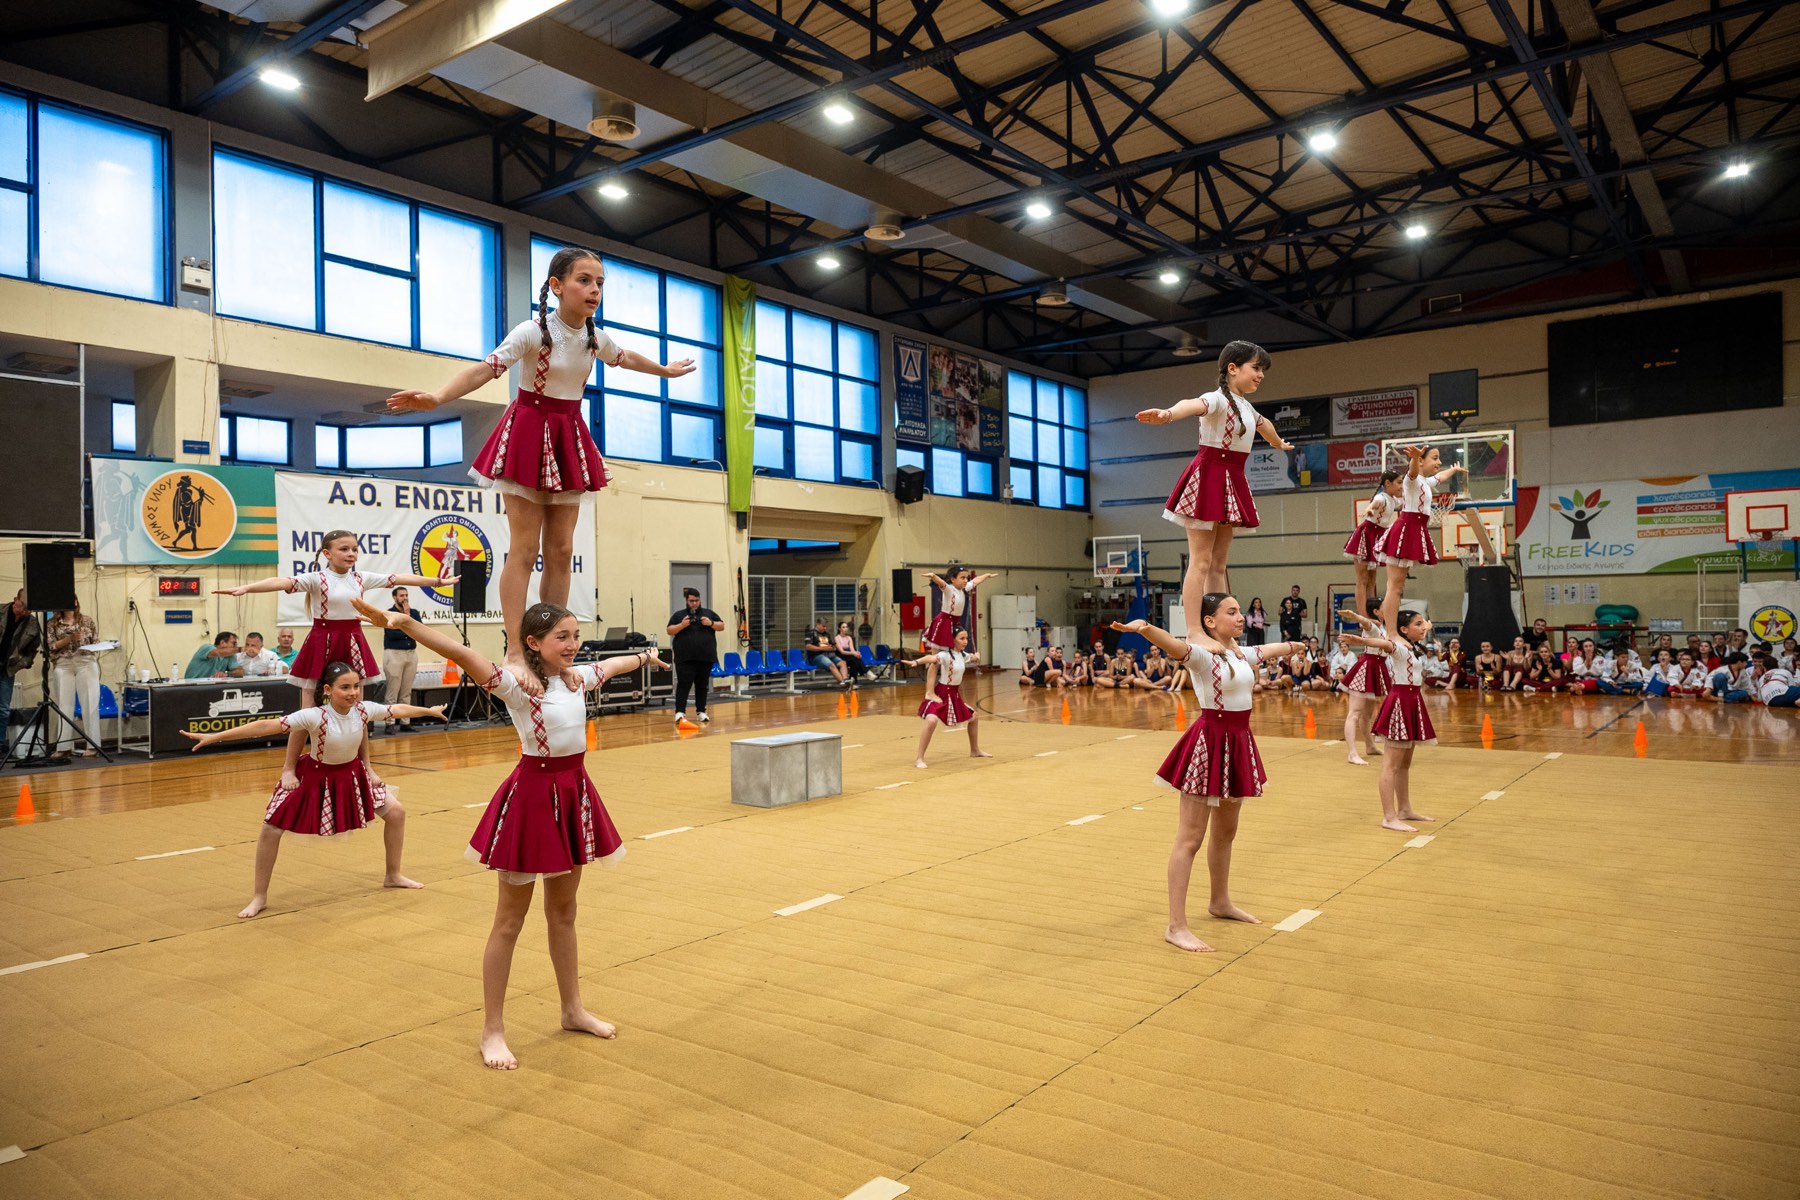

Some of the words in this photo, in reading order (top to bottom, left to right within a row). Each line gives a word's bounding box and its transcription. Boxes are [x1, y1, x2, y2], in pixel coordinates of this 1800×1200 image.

[1381, 391, 1414, 399] ΤΕΛΕΤΩΝ
[1351, 398, 1413, 411] ΦΩΤΕΙΝΟΠΟΥΛΟΥ
[1362, 408, 1402, 418] ΜΗΤΡΕΛΟΣ
[149, 478, 172, 503] ΙΛΙΟΥ
[328, 481, 382, 507] Α.Ο.
[395, 485, 483, 513] ΕΝΩΣΗ
[1653, 490, 1717, 503] λογοθεραπεία
[1653, 503, 1717, 513] εργοθεραπεία
[147, 505, 171, 541] ΔΗΜΟΣ
[1653, 515, 1717, 524] ψυχοθεραπεία
[422, 516, 458, 535] ΑΘΛΗΤΙΚΟΣ
[459, 516, 484, 538] ΟΜΙΛΟΣ
[1638, 529, 1663, 538] ειδική
[1594, 561, 1625, 570] Αγωγής
[434, 610, 451, 619] ΝΑΙ
